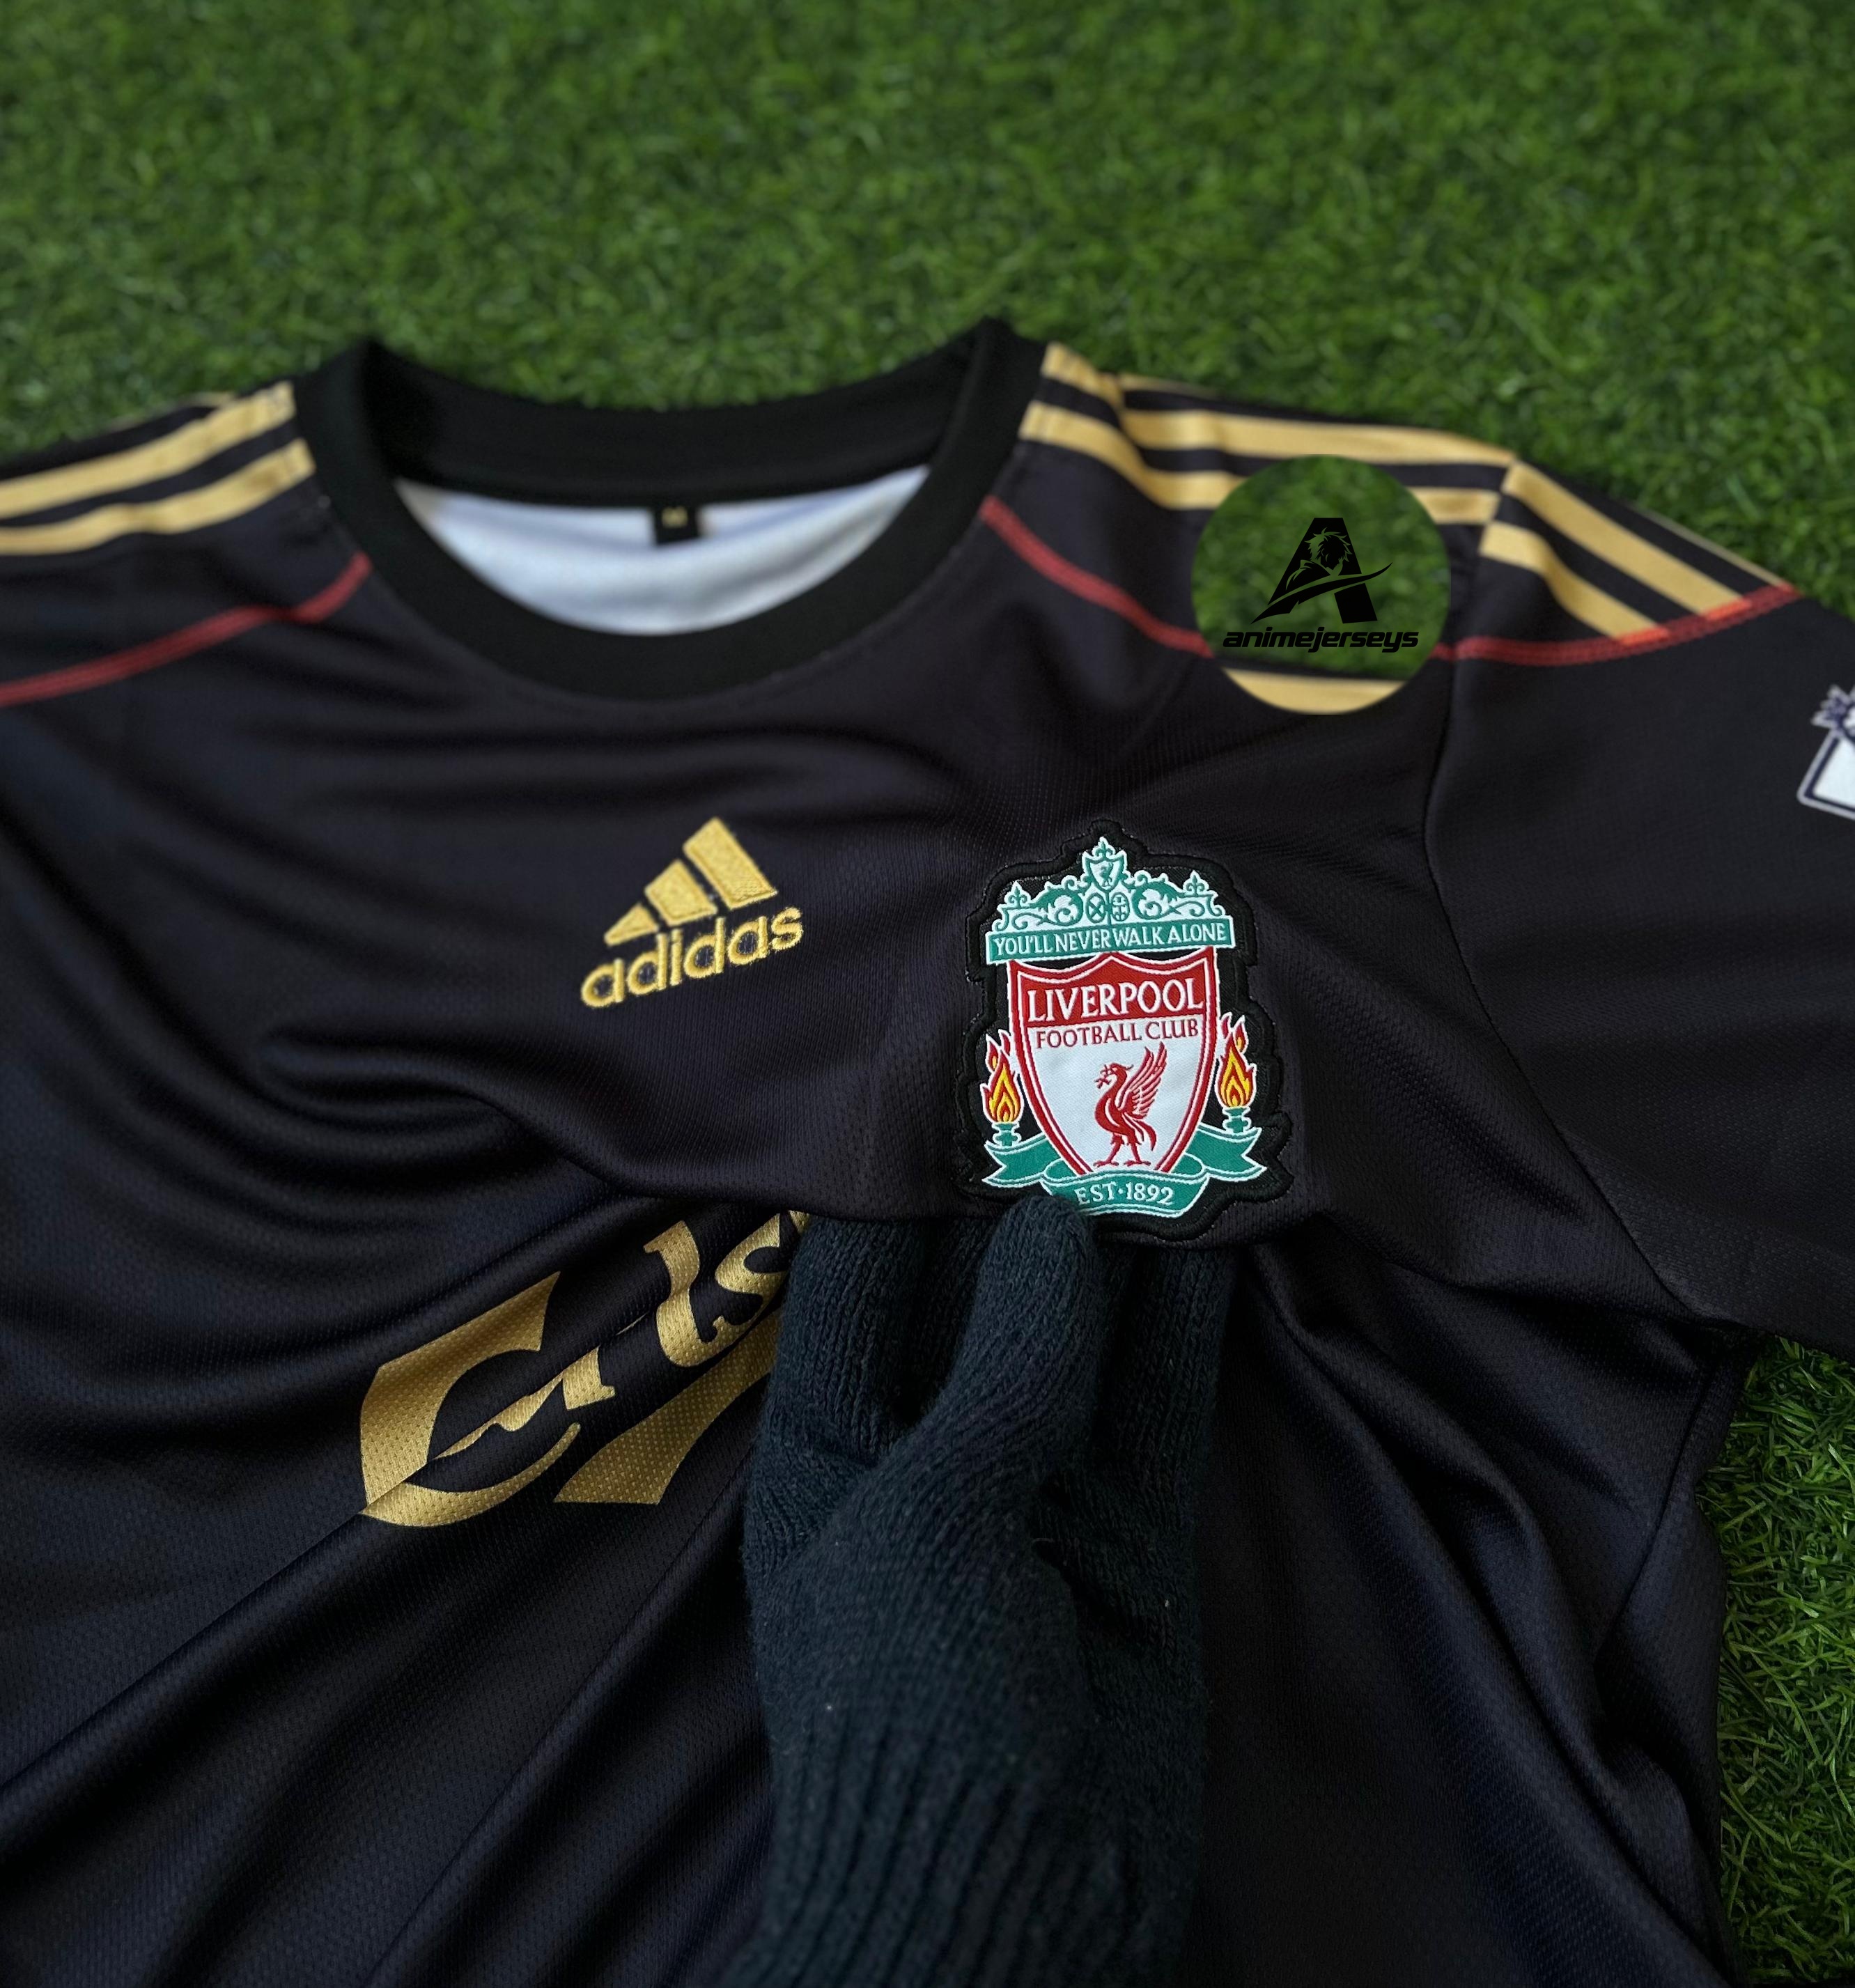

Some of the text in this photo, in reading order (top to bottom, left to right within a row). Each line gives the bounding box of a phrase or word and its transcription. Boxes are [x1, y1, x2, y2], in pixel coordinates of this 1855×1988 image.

[581, 906, 803, 1007] adidas
[993, 922, 1227, 956] YOU'LL NEVER WALK ALONE
[1027, 977, 1204, 1023] LIVERPOOL
[1036, 1018, 1199, 1049] FOOTBALL CLUB
